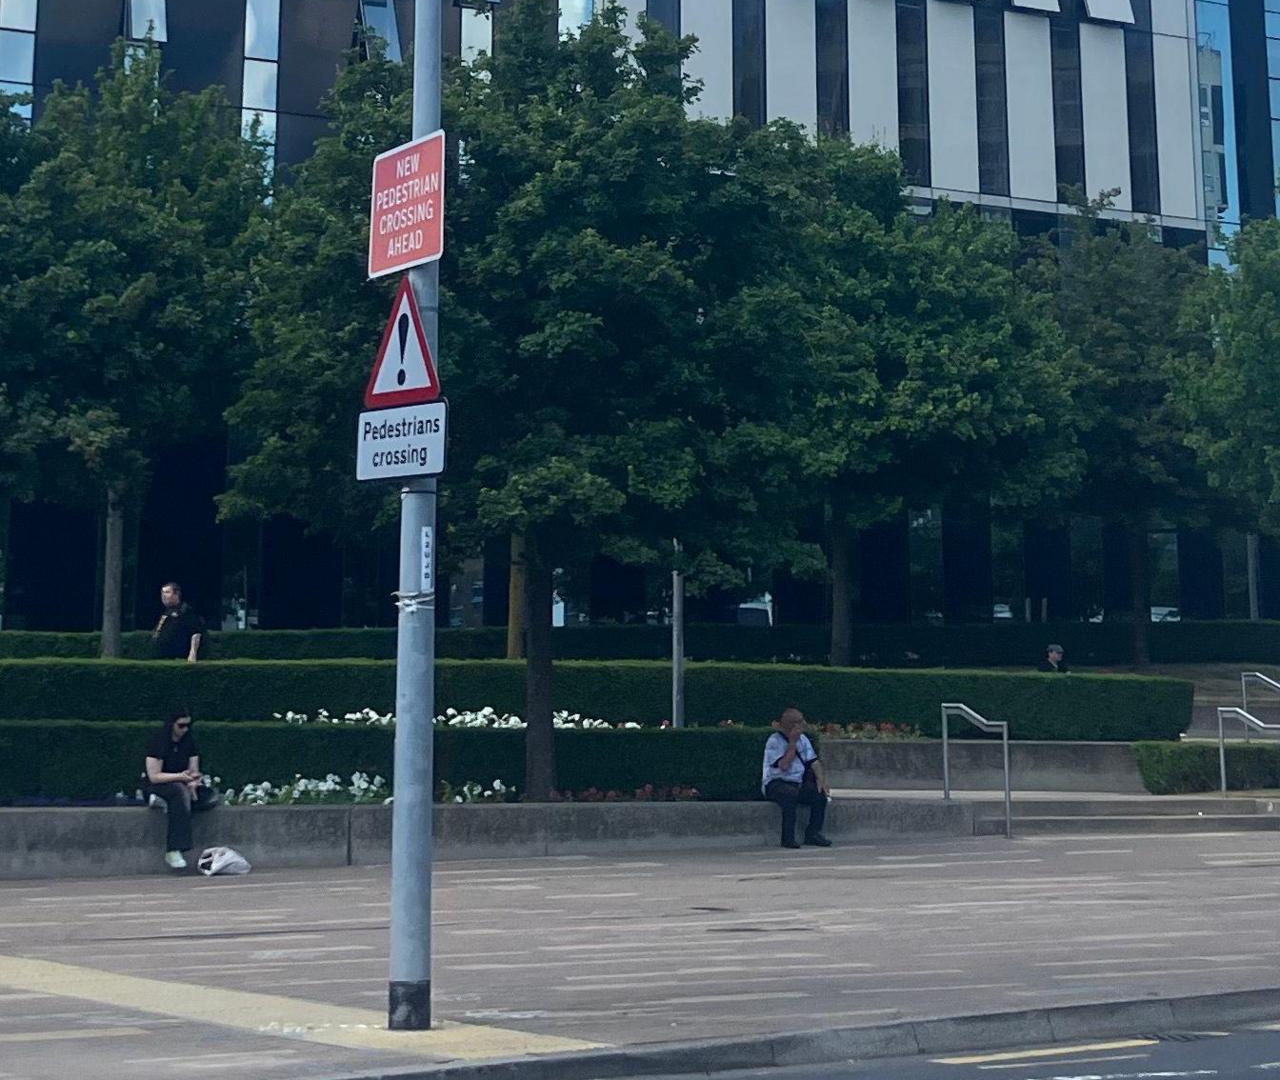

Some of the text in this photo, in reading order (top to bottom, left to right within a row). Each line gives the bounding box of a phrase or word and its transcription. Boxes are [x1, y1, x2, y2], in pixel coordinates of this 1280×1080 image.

[396, 153, 420, 179] NEW
[376, 172, 439, 211] PEDESTRIAN
[380, 199, 434, 235] CROSSING
[387, 229, 423, 258] AHEAD
[363, 416, 440, 441] Pedestrians
[372, 444, 427, 467] crossing
